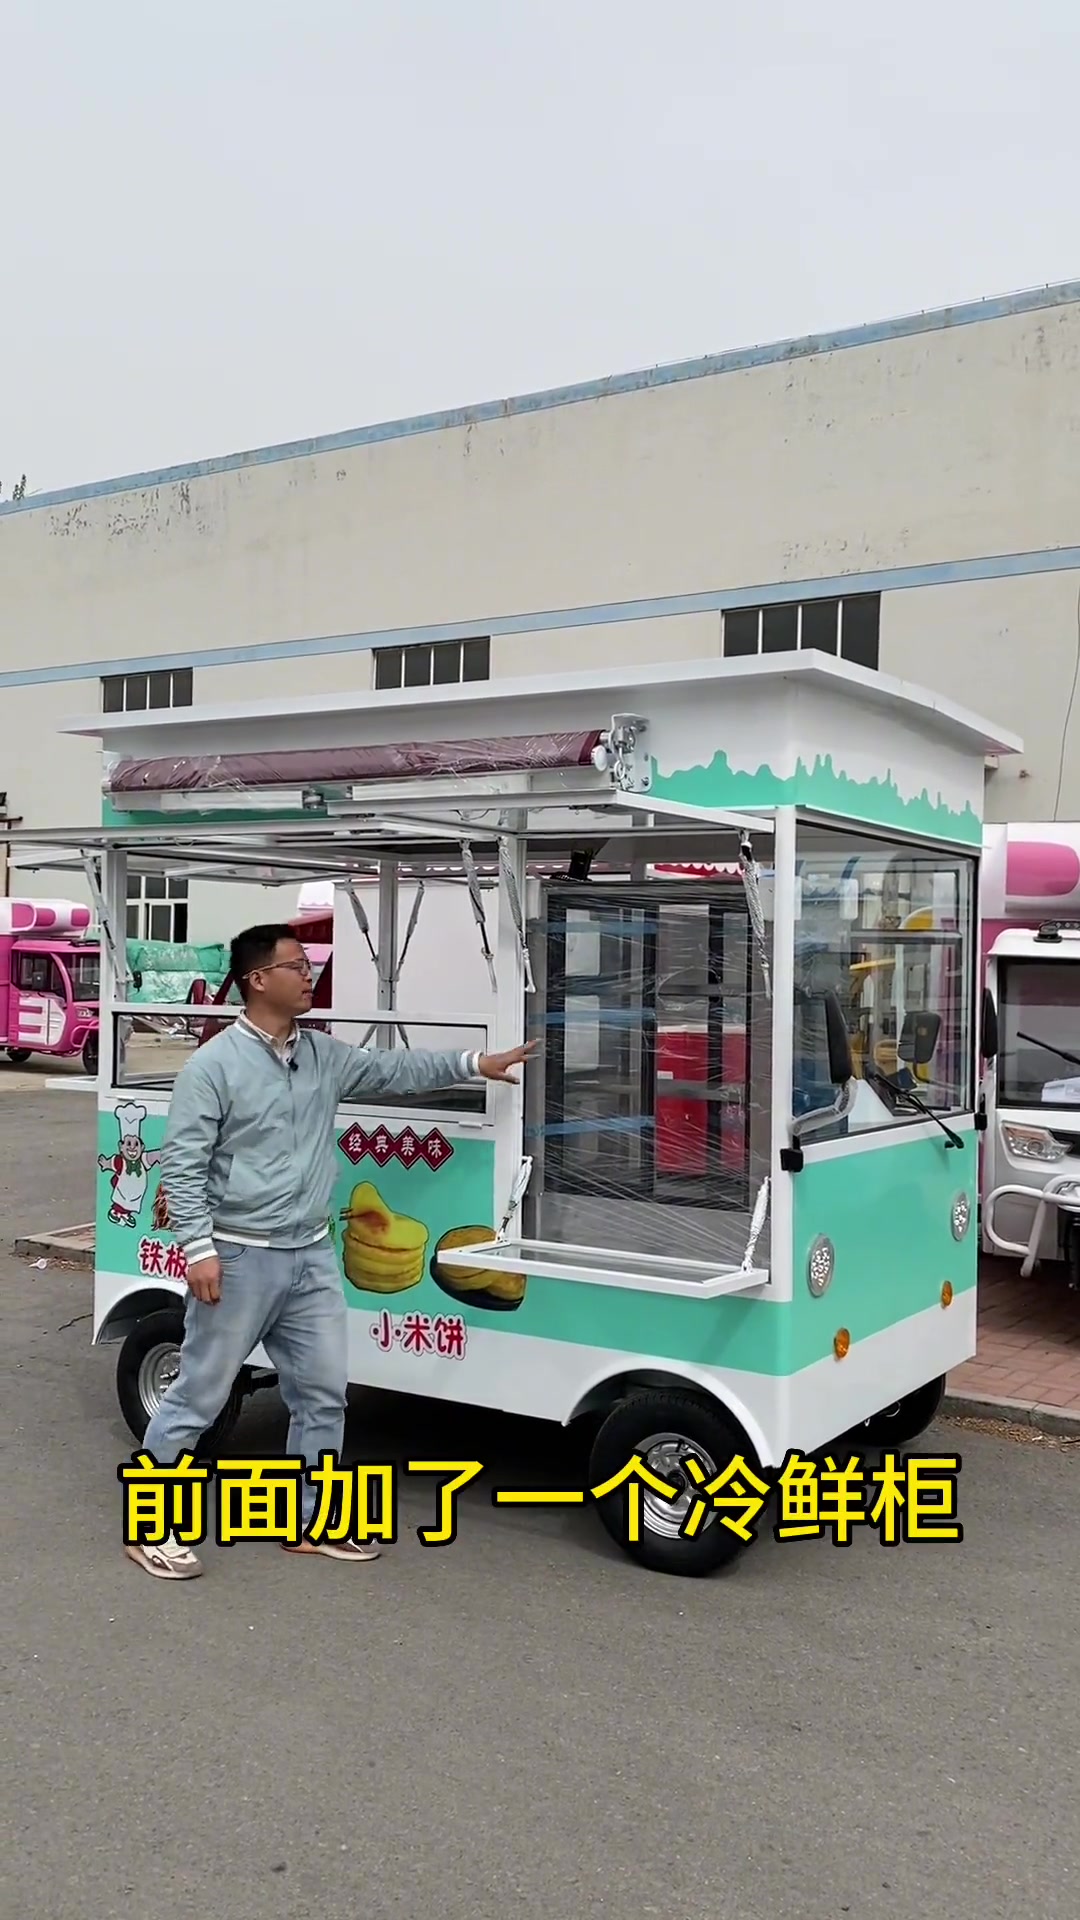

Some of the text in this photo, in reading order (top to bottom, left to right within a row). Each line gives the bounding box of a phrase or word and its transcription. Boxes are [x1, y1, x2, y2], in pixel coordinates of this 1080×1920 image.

[348, 1132, 443, 1159] 经典美味
[372, 1311, 464, 1357] 小米饼
